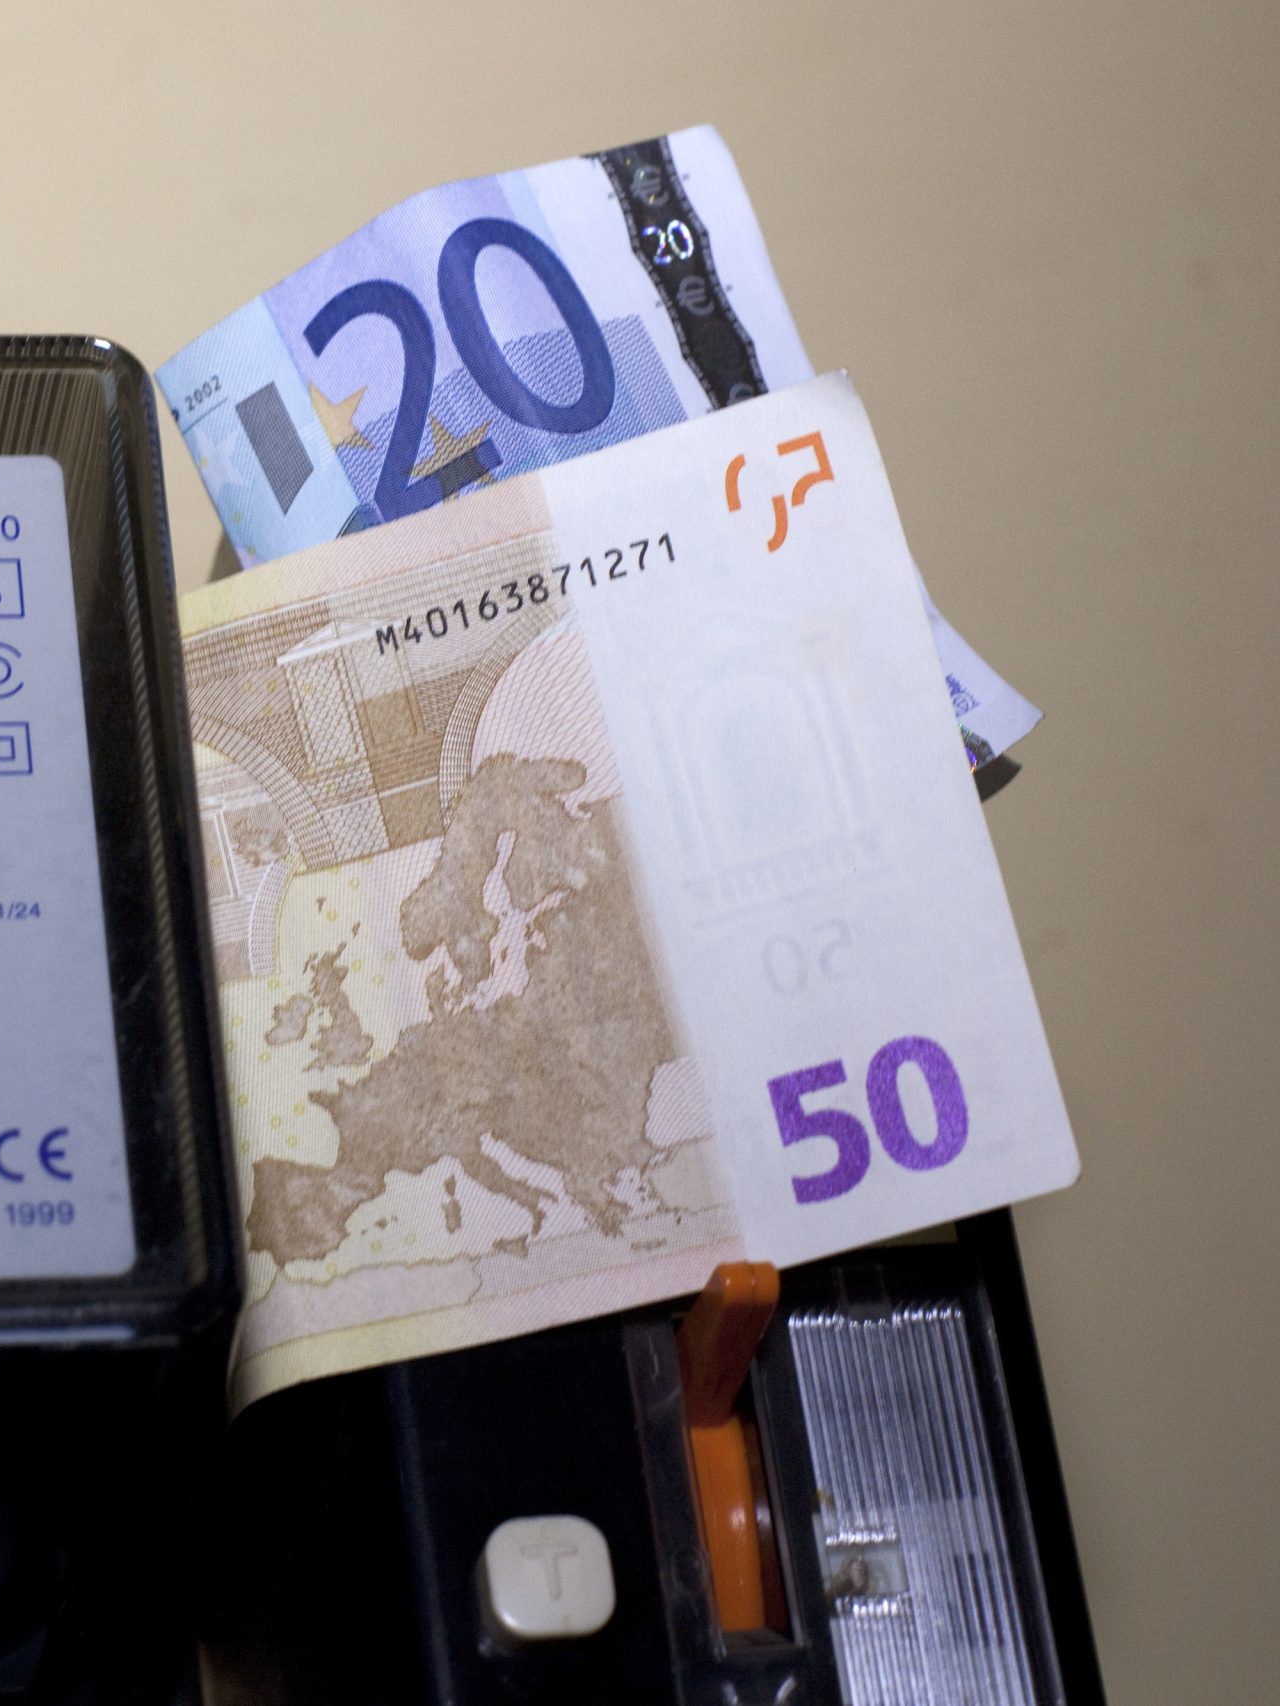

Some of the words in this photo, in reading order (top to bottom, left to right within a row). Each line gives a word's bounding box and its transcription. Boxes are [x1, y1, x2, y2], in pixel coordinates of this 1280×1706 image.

[642, 219, 694, 265] 20
[184, 374, 222, 412] 2002
[303, 216, 616, 525] 20
[375, 533, 675, 655] M40163871271
[766, 1035, 969, 1205] 50
[6, 1201, 75, 1227] 1999
[519, 1543, 580, 1602] T
